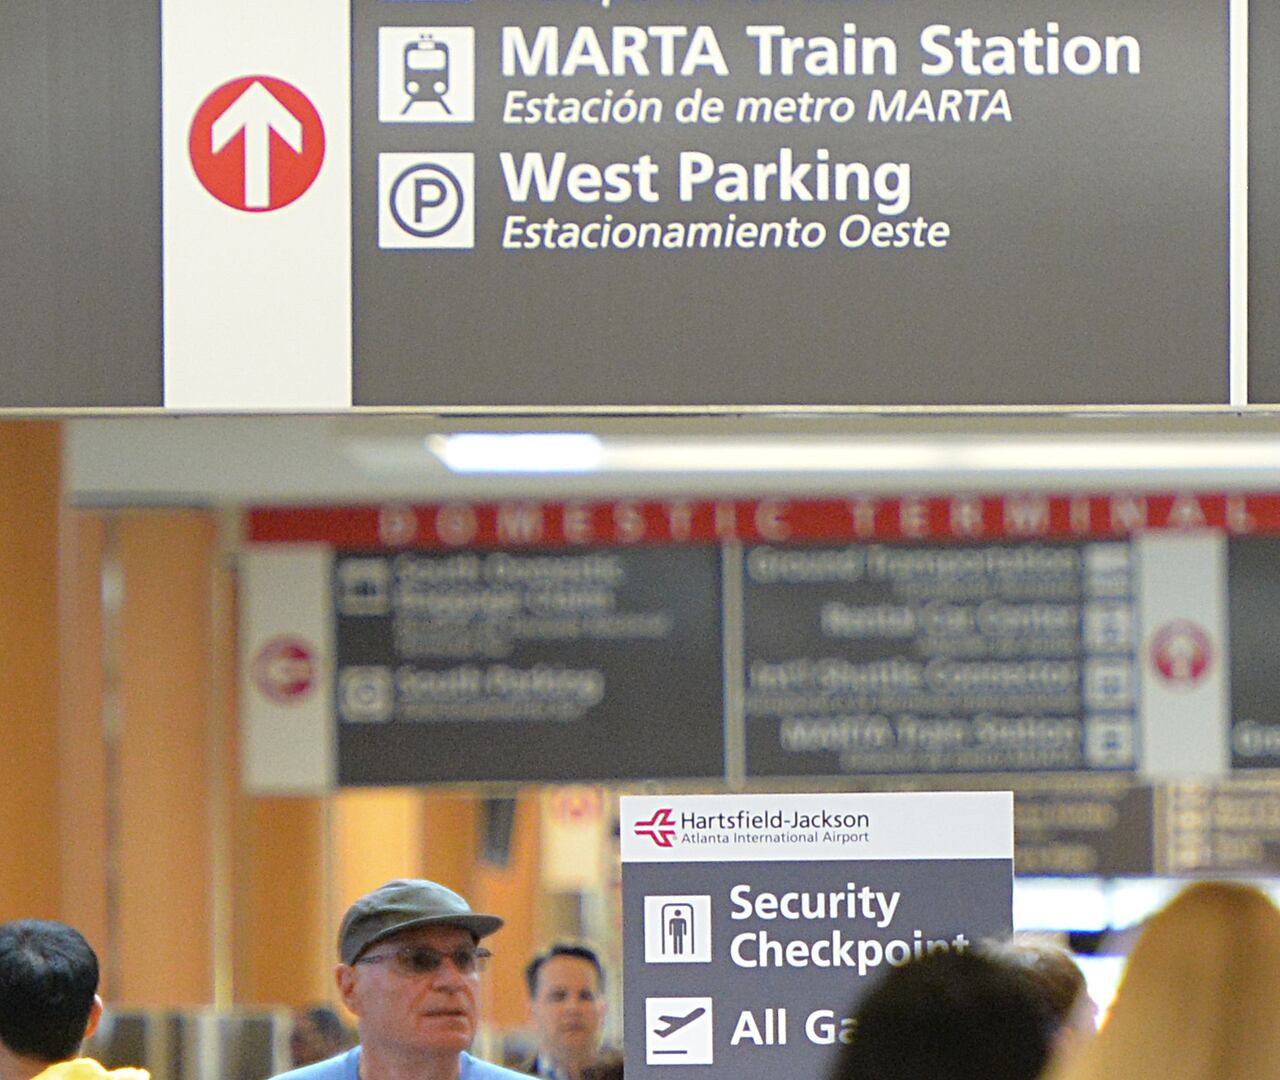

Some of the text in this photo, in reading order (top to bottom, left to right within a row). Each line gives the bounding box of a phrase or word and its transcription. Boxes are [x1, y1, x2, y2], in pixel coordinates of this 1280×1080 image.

[502, 21, 1141, 77] MARTA Train Station
[502, 87, 1012, 124] Estación de metro MARTA
[499, 147, 911, 215] West Parking
[502, 213, 951, 249] Estacionamiento Oeste
[377, 498, 792, 545] DOMESTIC
[852, 495, 1254, 540] TERMINAL
[681, 809, 869, 830] Hartsfield-Jackson
[681, 831, 869, 845] Atlanta International Airport
[730, 882, 901, 928] Security
[730, 1007, 787, 1046] All
